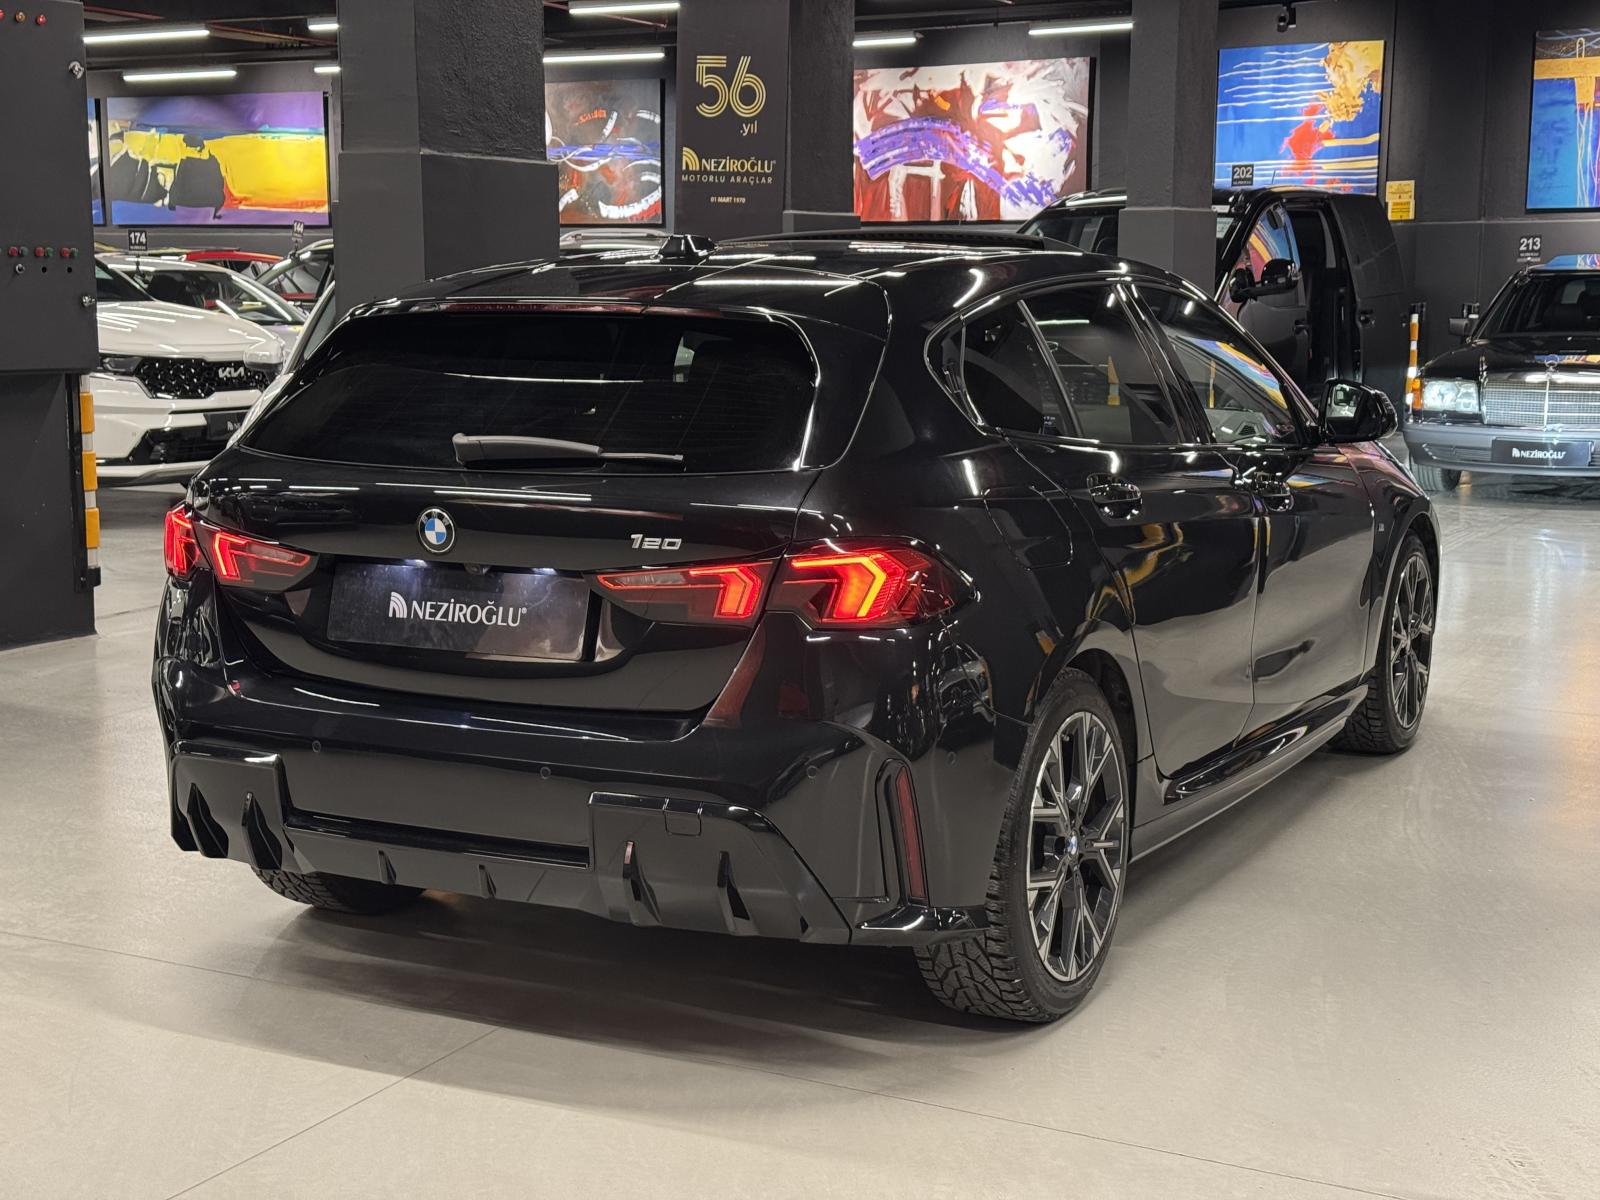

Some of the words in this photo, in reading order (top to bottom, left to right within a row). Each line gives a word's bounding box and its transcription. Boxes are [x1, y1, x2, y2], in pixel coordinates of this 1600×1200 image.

[696, 55, 766, 117] 56
[681, 174, 726, 183] MOTORLU
[730, 175, 773, 186] ARAÇLAR
[1233, 167, 1253, 179] 202
[129, 231, 147, 245] 174
[1519, 237, 1541, 251] 213
[630, 533, 683, 551] 120
